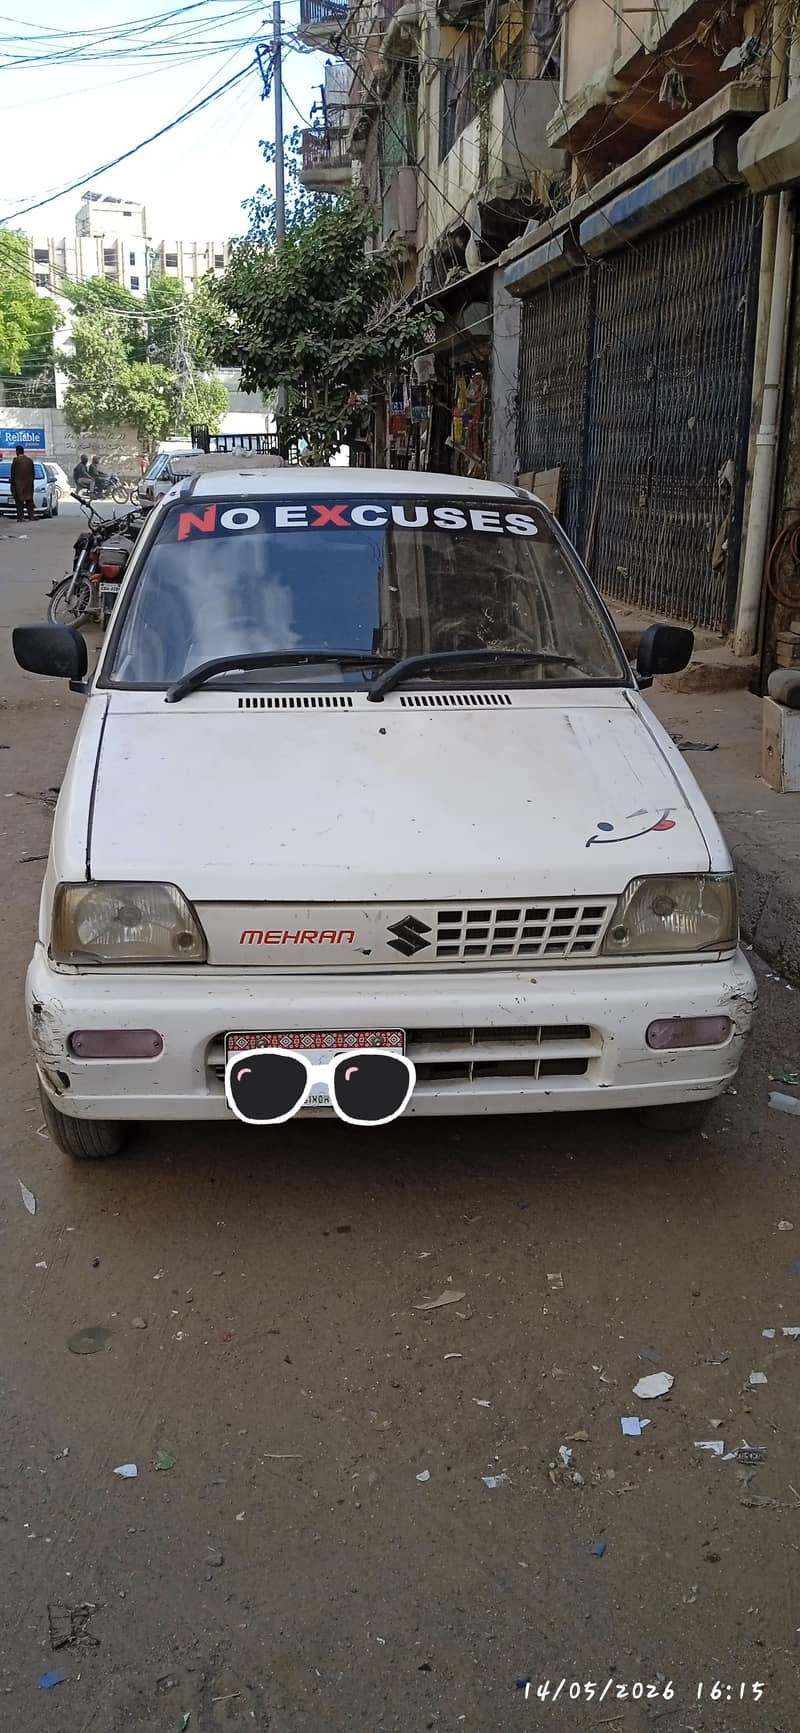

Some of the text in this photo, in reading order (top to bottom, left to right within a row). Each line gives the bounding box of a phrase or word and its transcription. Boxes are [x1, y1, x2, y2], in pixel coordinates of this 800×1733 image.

[5, 432, 41, 442] Reliable
[177, 504, 538, 541] NO EXCUSES
[239, 930, 356, 945] MEHRAN
